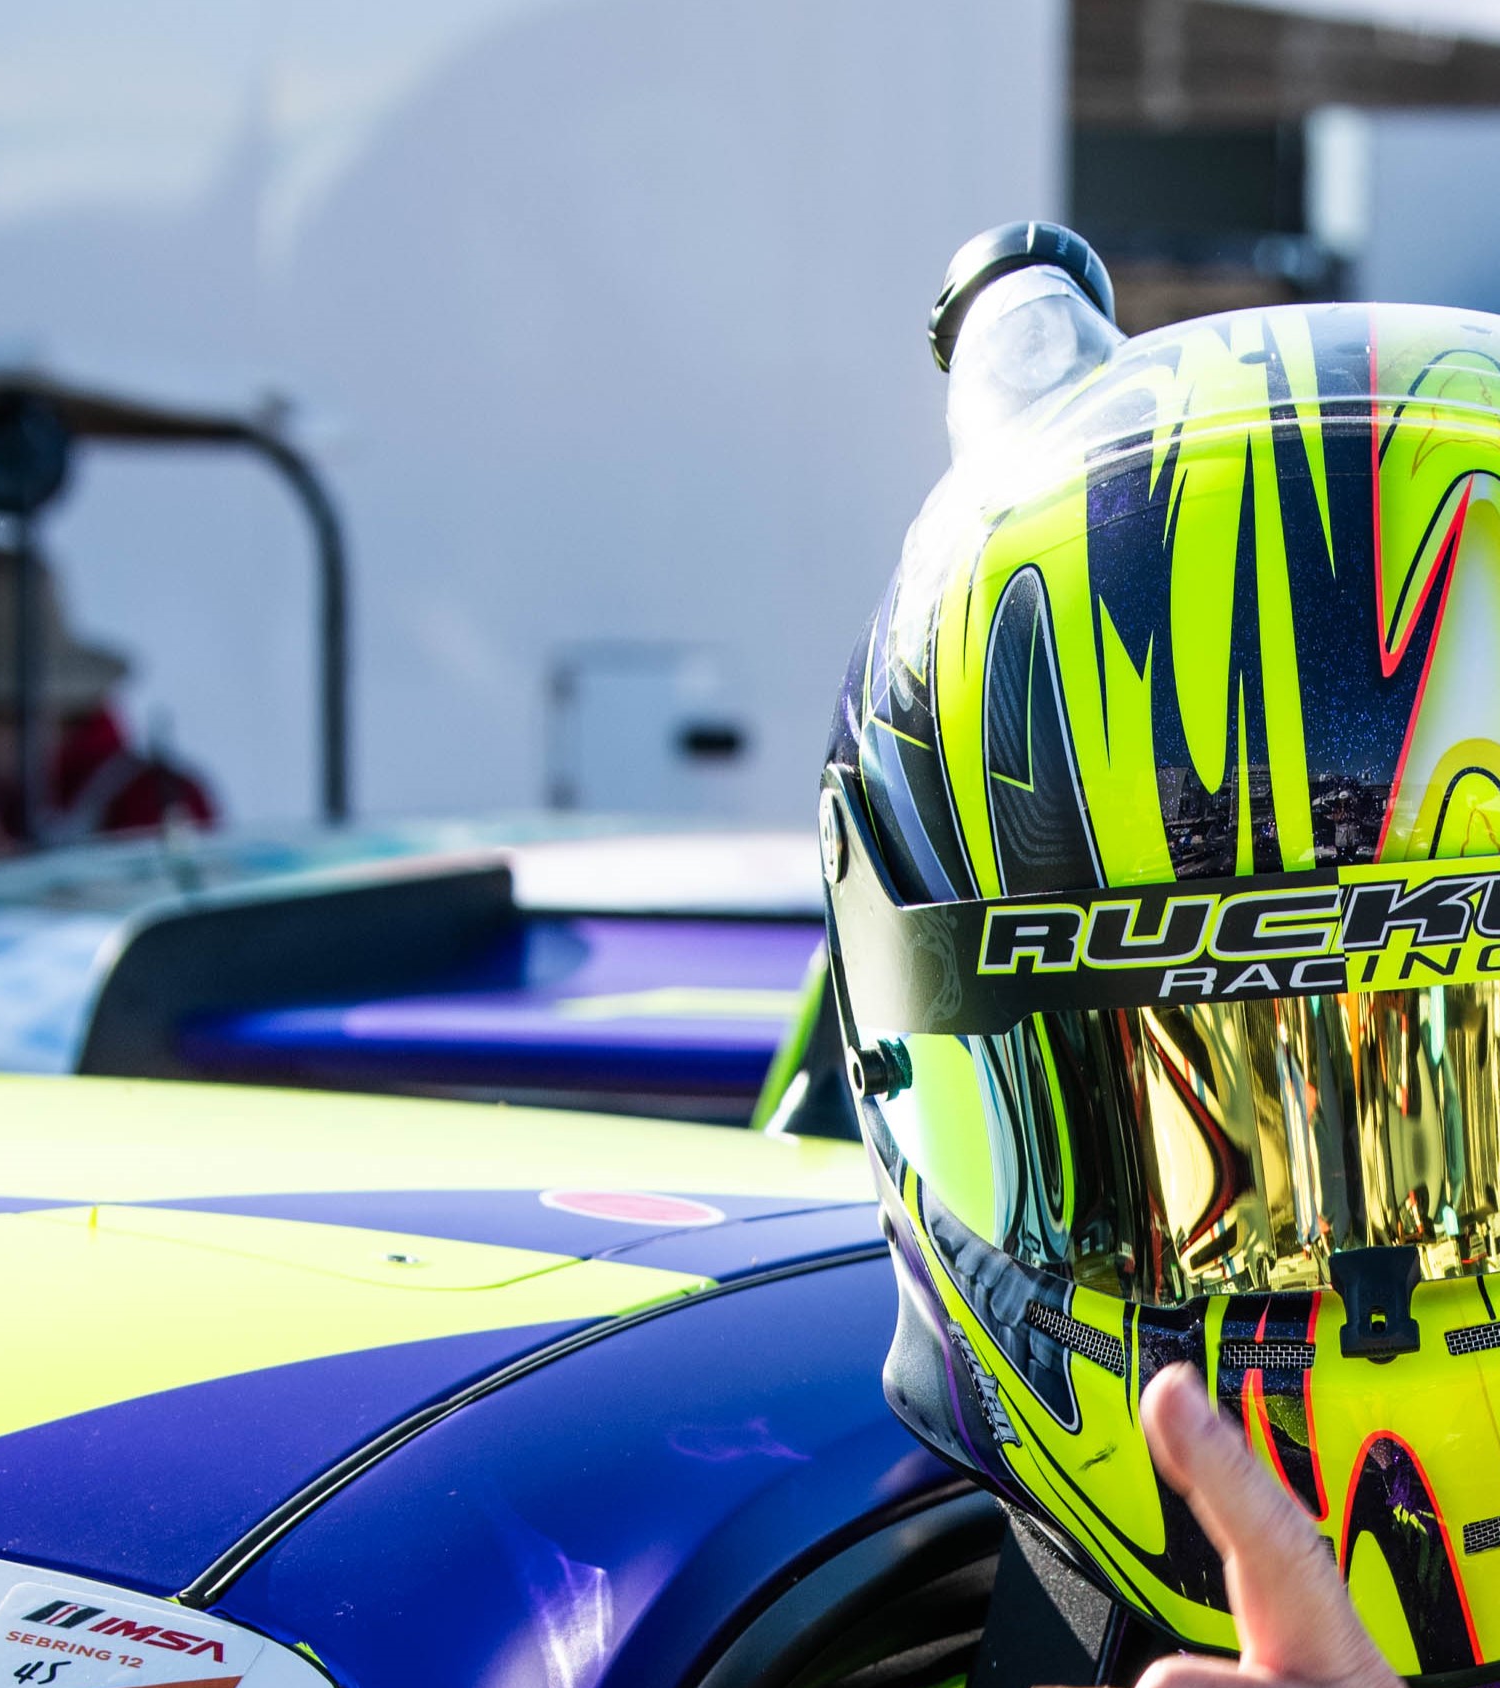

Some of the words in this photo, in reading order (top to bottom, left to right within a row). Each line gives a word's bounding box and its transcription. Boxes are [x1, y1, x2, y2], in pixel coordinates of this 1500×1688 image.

[5, 1630, 112, 1662] SEBRING
[117, 1653, 145, 1670] 12
[87, 1616, 228, 1664] IMSA
[13, 1660, 71, 1685] 45
